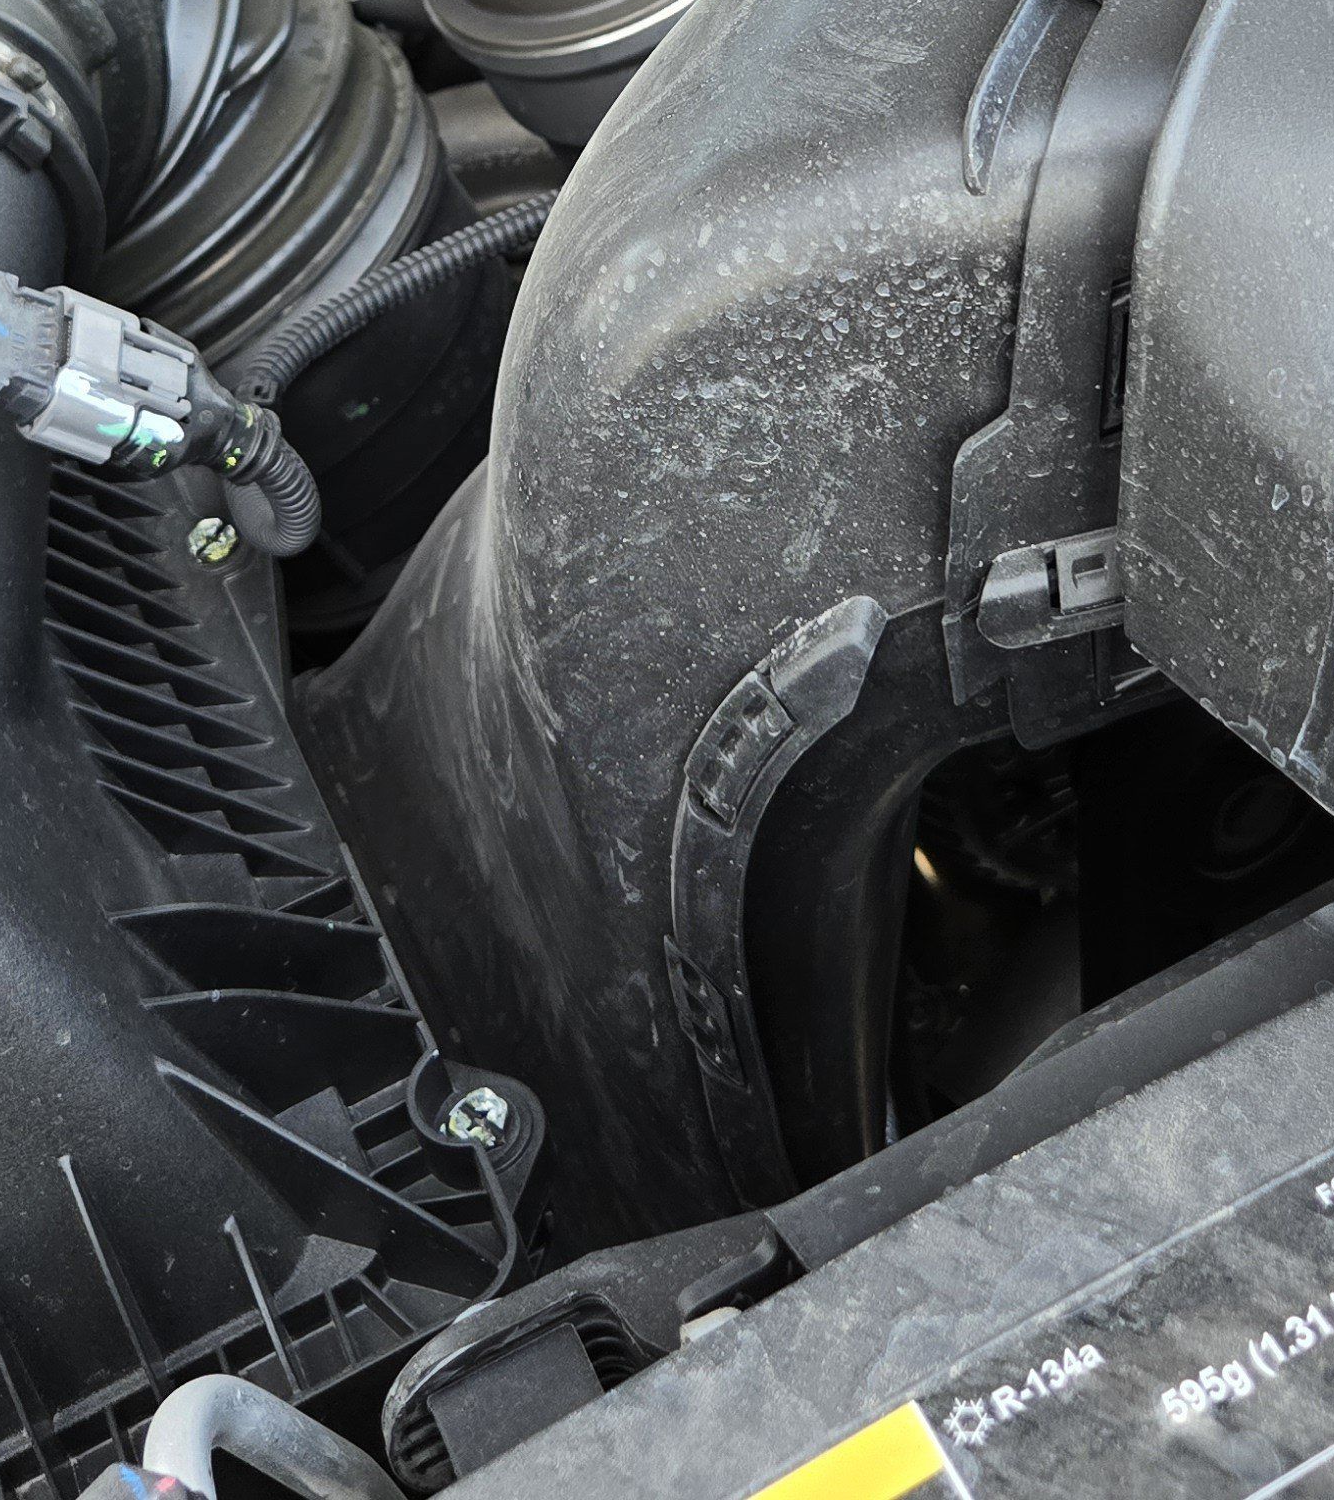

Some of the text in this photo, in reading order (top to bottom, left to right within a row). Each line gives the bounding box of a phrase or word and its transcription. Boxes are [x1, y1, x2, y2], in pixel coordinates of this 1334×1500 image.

[990, 1343, 1107, 1420] R-134a
[1161, 1359, 1256, 1424] 595g
[1248, 1303, 1334, 1378] (1.31
